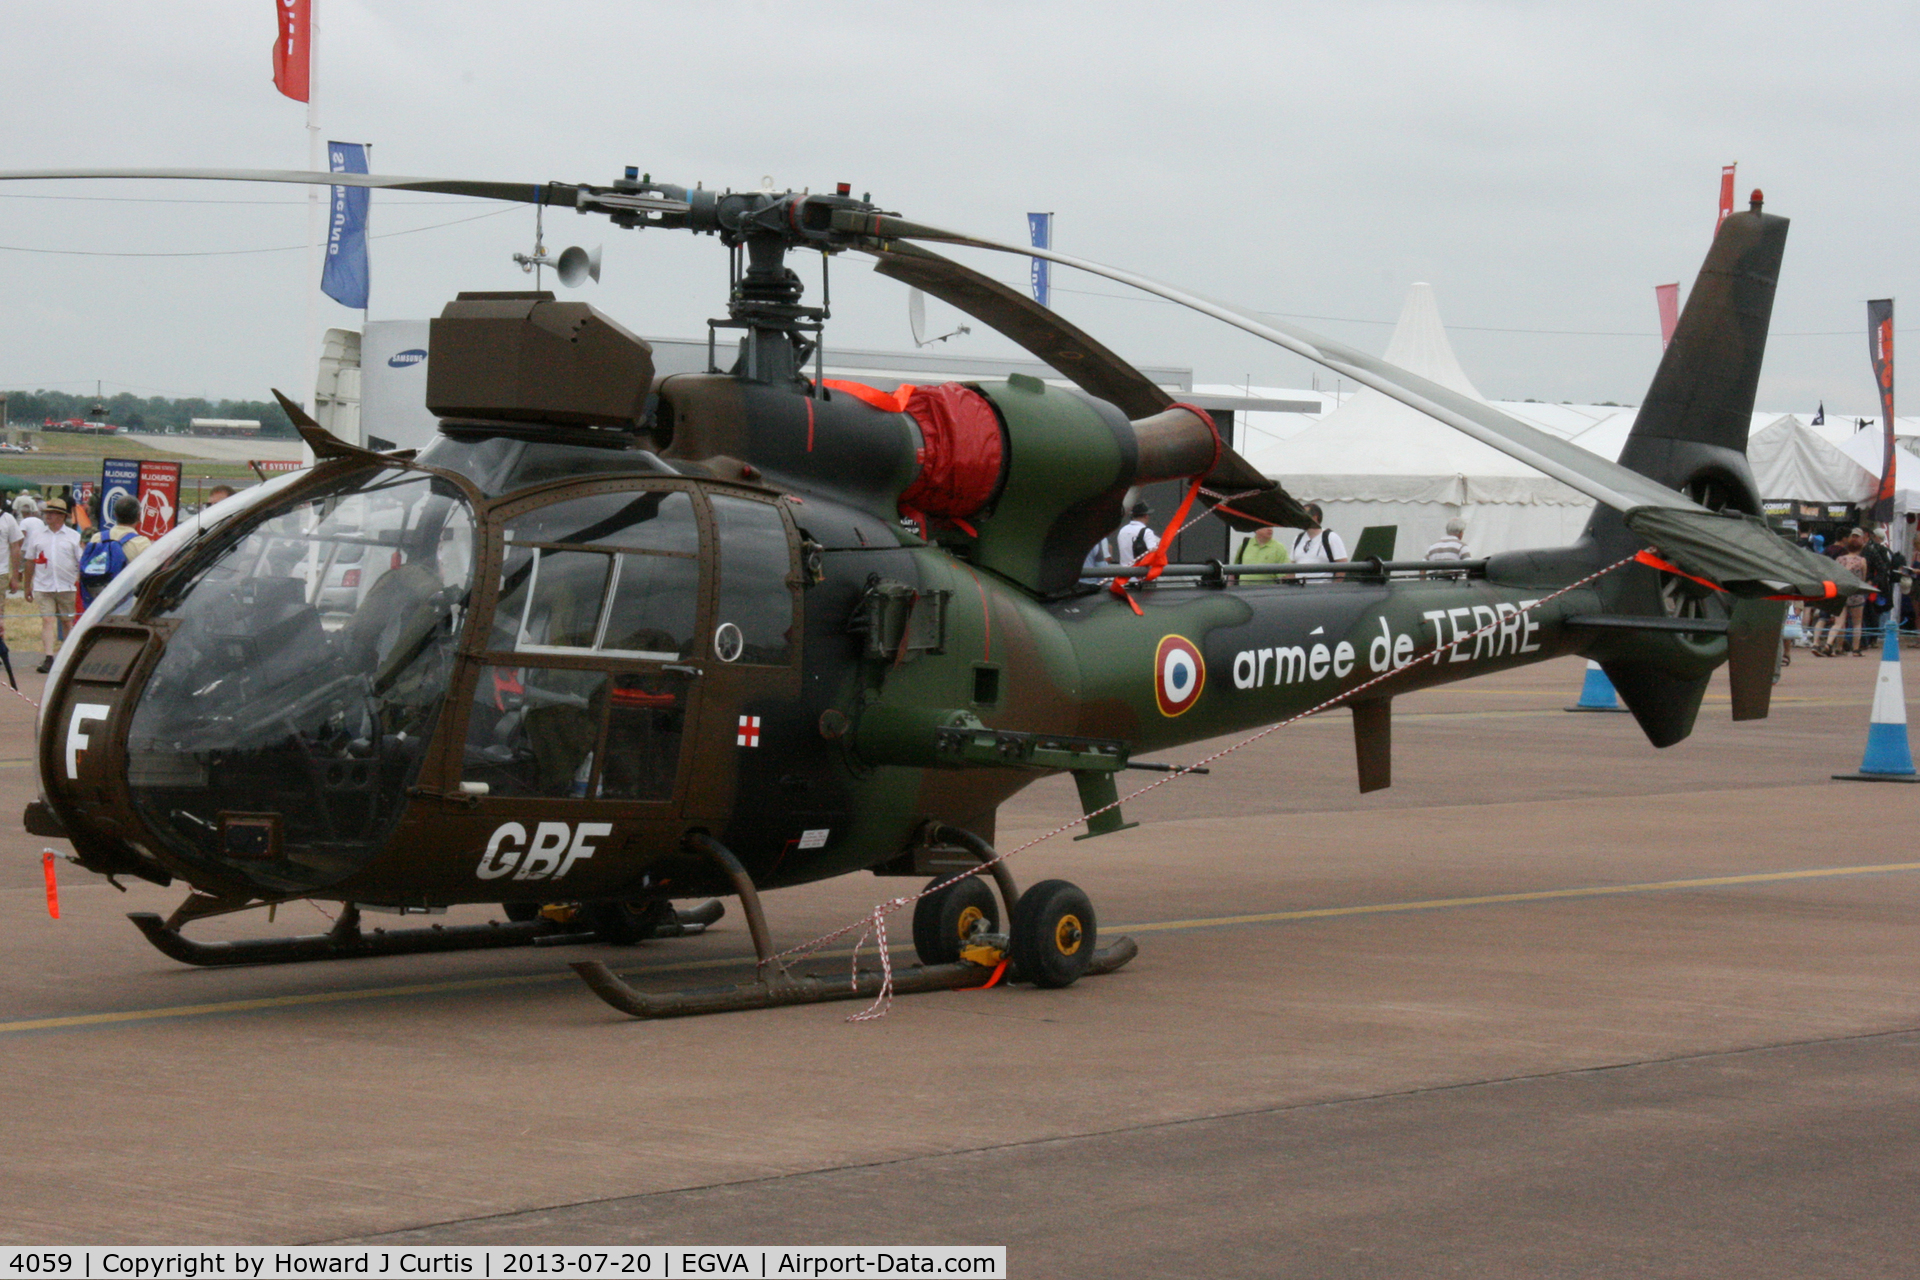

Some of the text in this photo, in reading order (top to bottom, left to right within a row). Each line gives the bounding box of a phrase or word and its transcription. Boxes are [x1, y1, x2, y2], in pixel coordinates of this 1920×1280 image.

[1233, 599, 1541, 690] armée de TERRE
[66, 703, 111, 779] F
[476, 821, 613, 880] GBF
